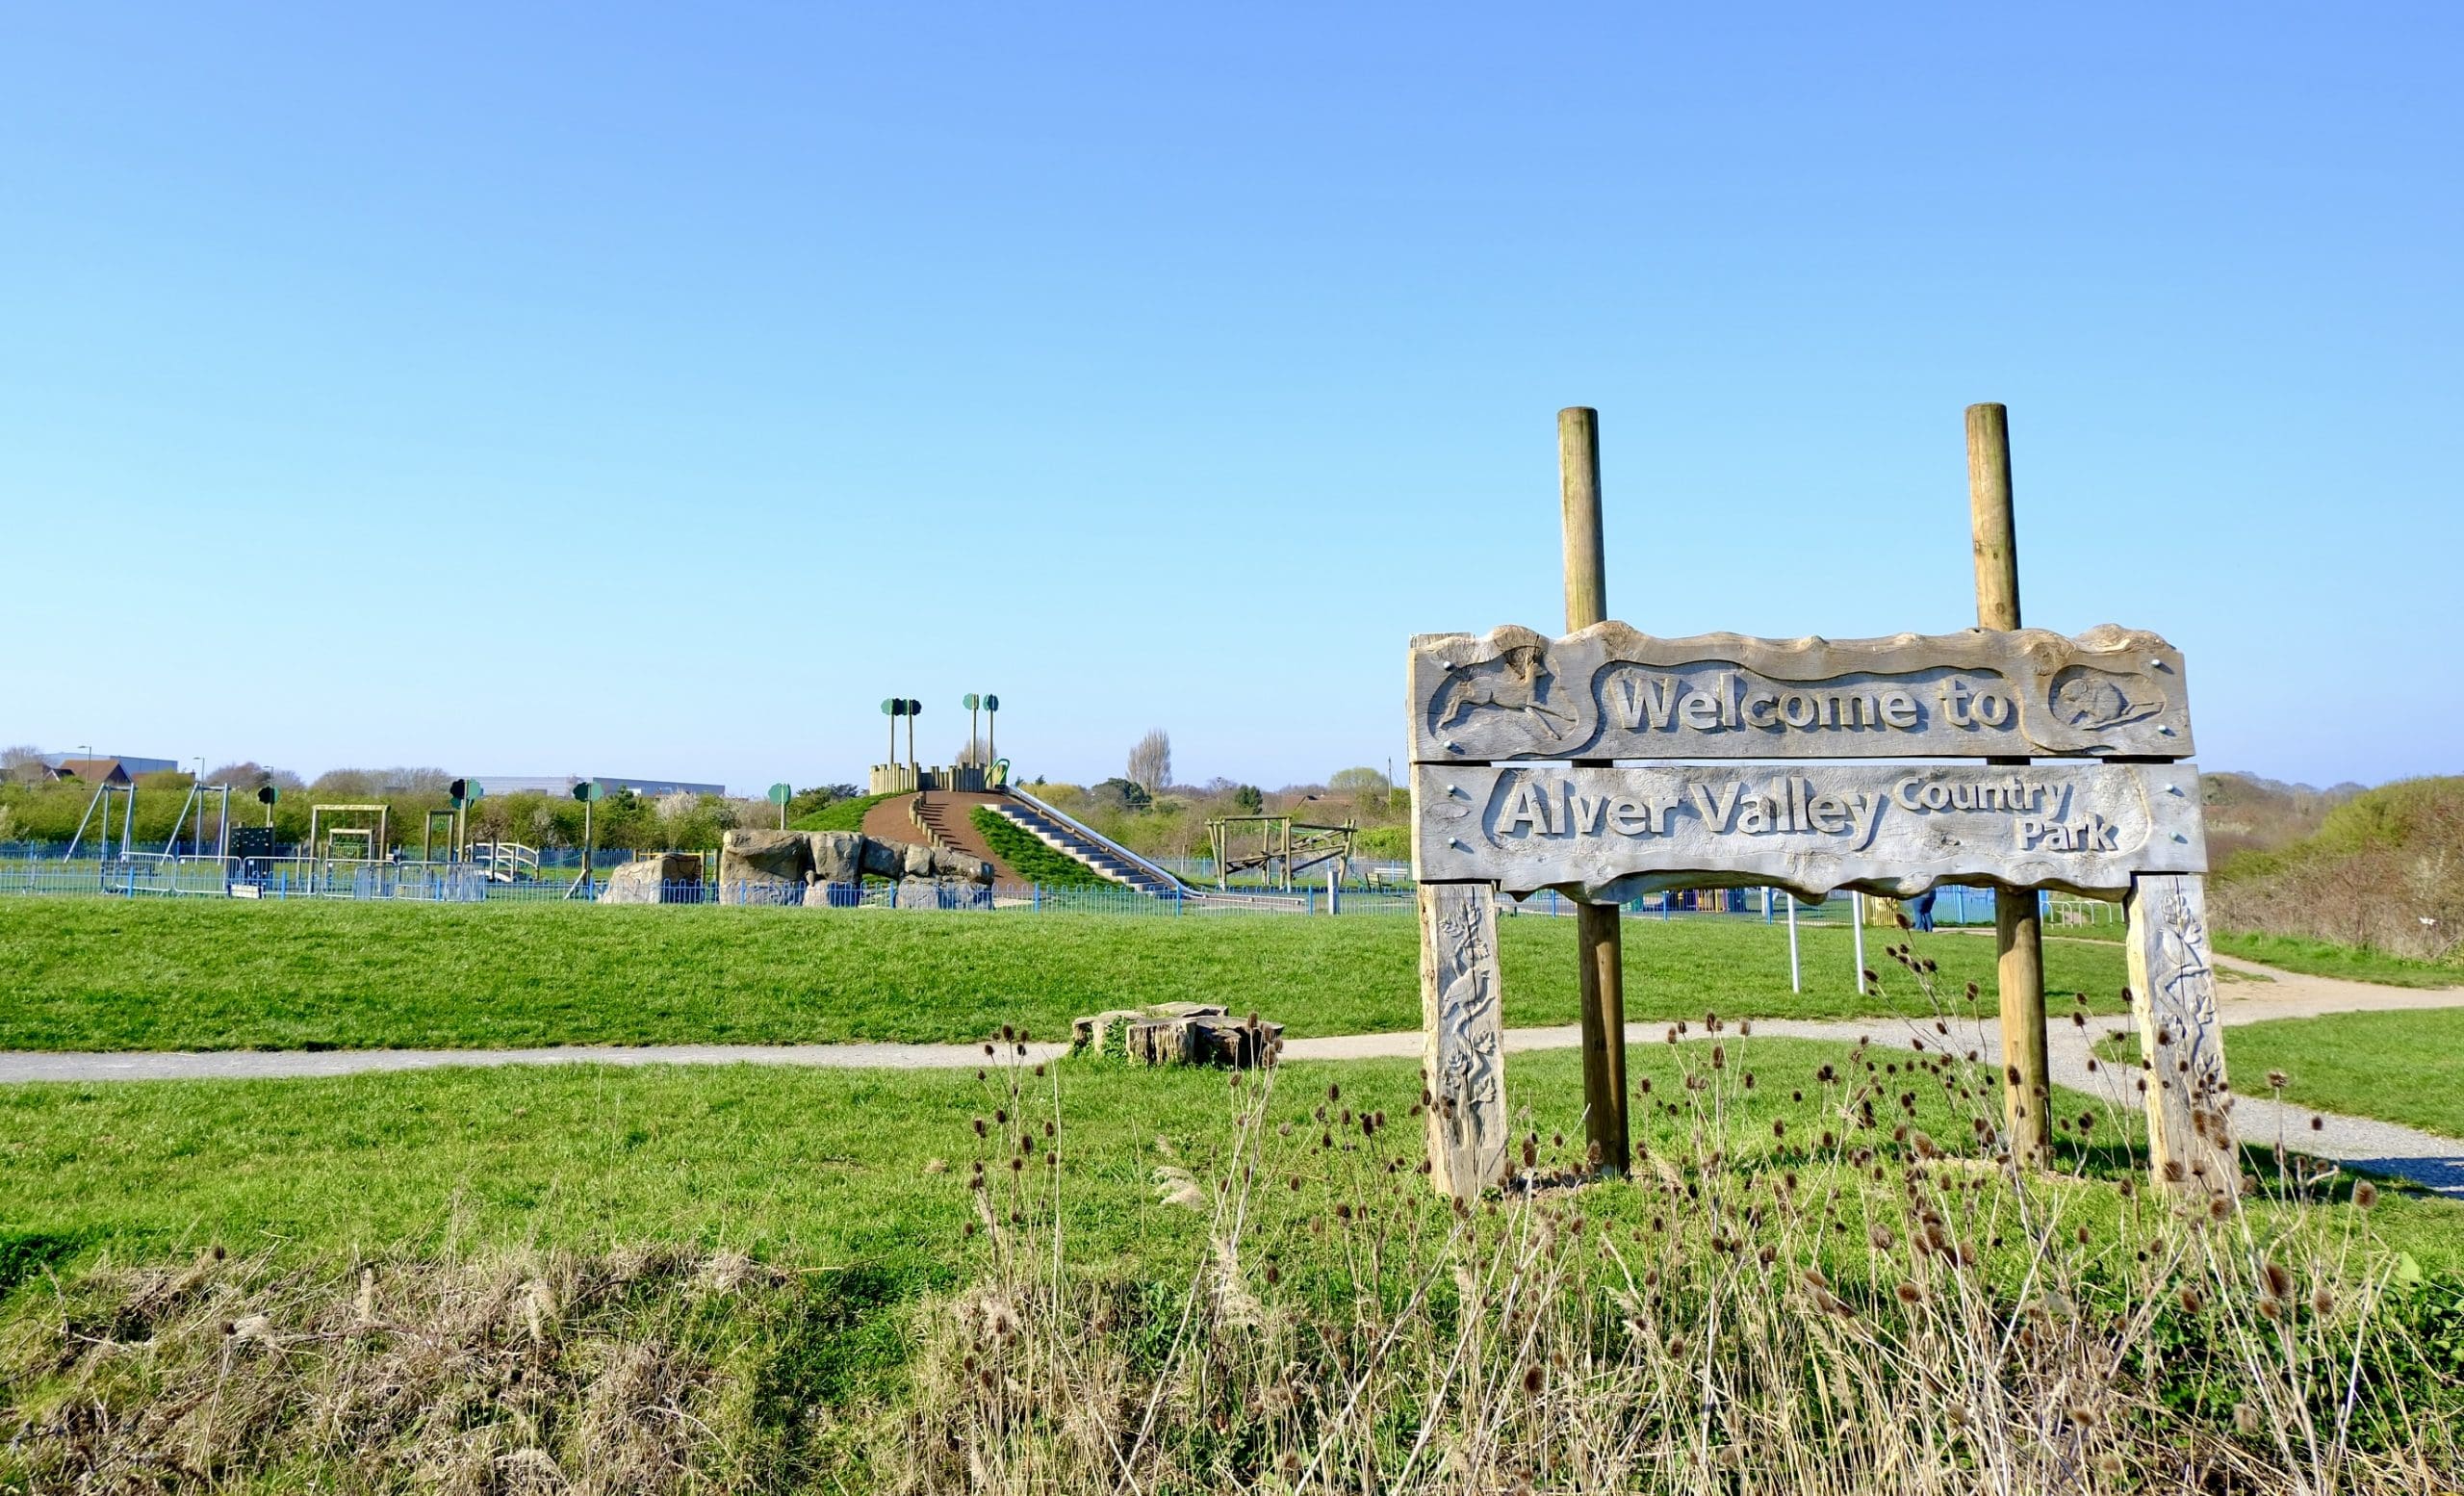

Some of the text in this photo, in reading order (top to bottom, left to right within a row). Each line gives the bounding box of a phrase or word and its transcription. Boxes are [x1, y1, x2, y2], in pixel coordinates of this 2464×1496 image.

[1608, 672, 2010, 731] Welcome to
[1498, 776, 1882, 851] Alver Valley
[1892, 776, 2070, 818] Country
[2017, 816, 2118, 852] Park
